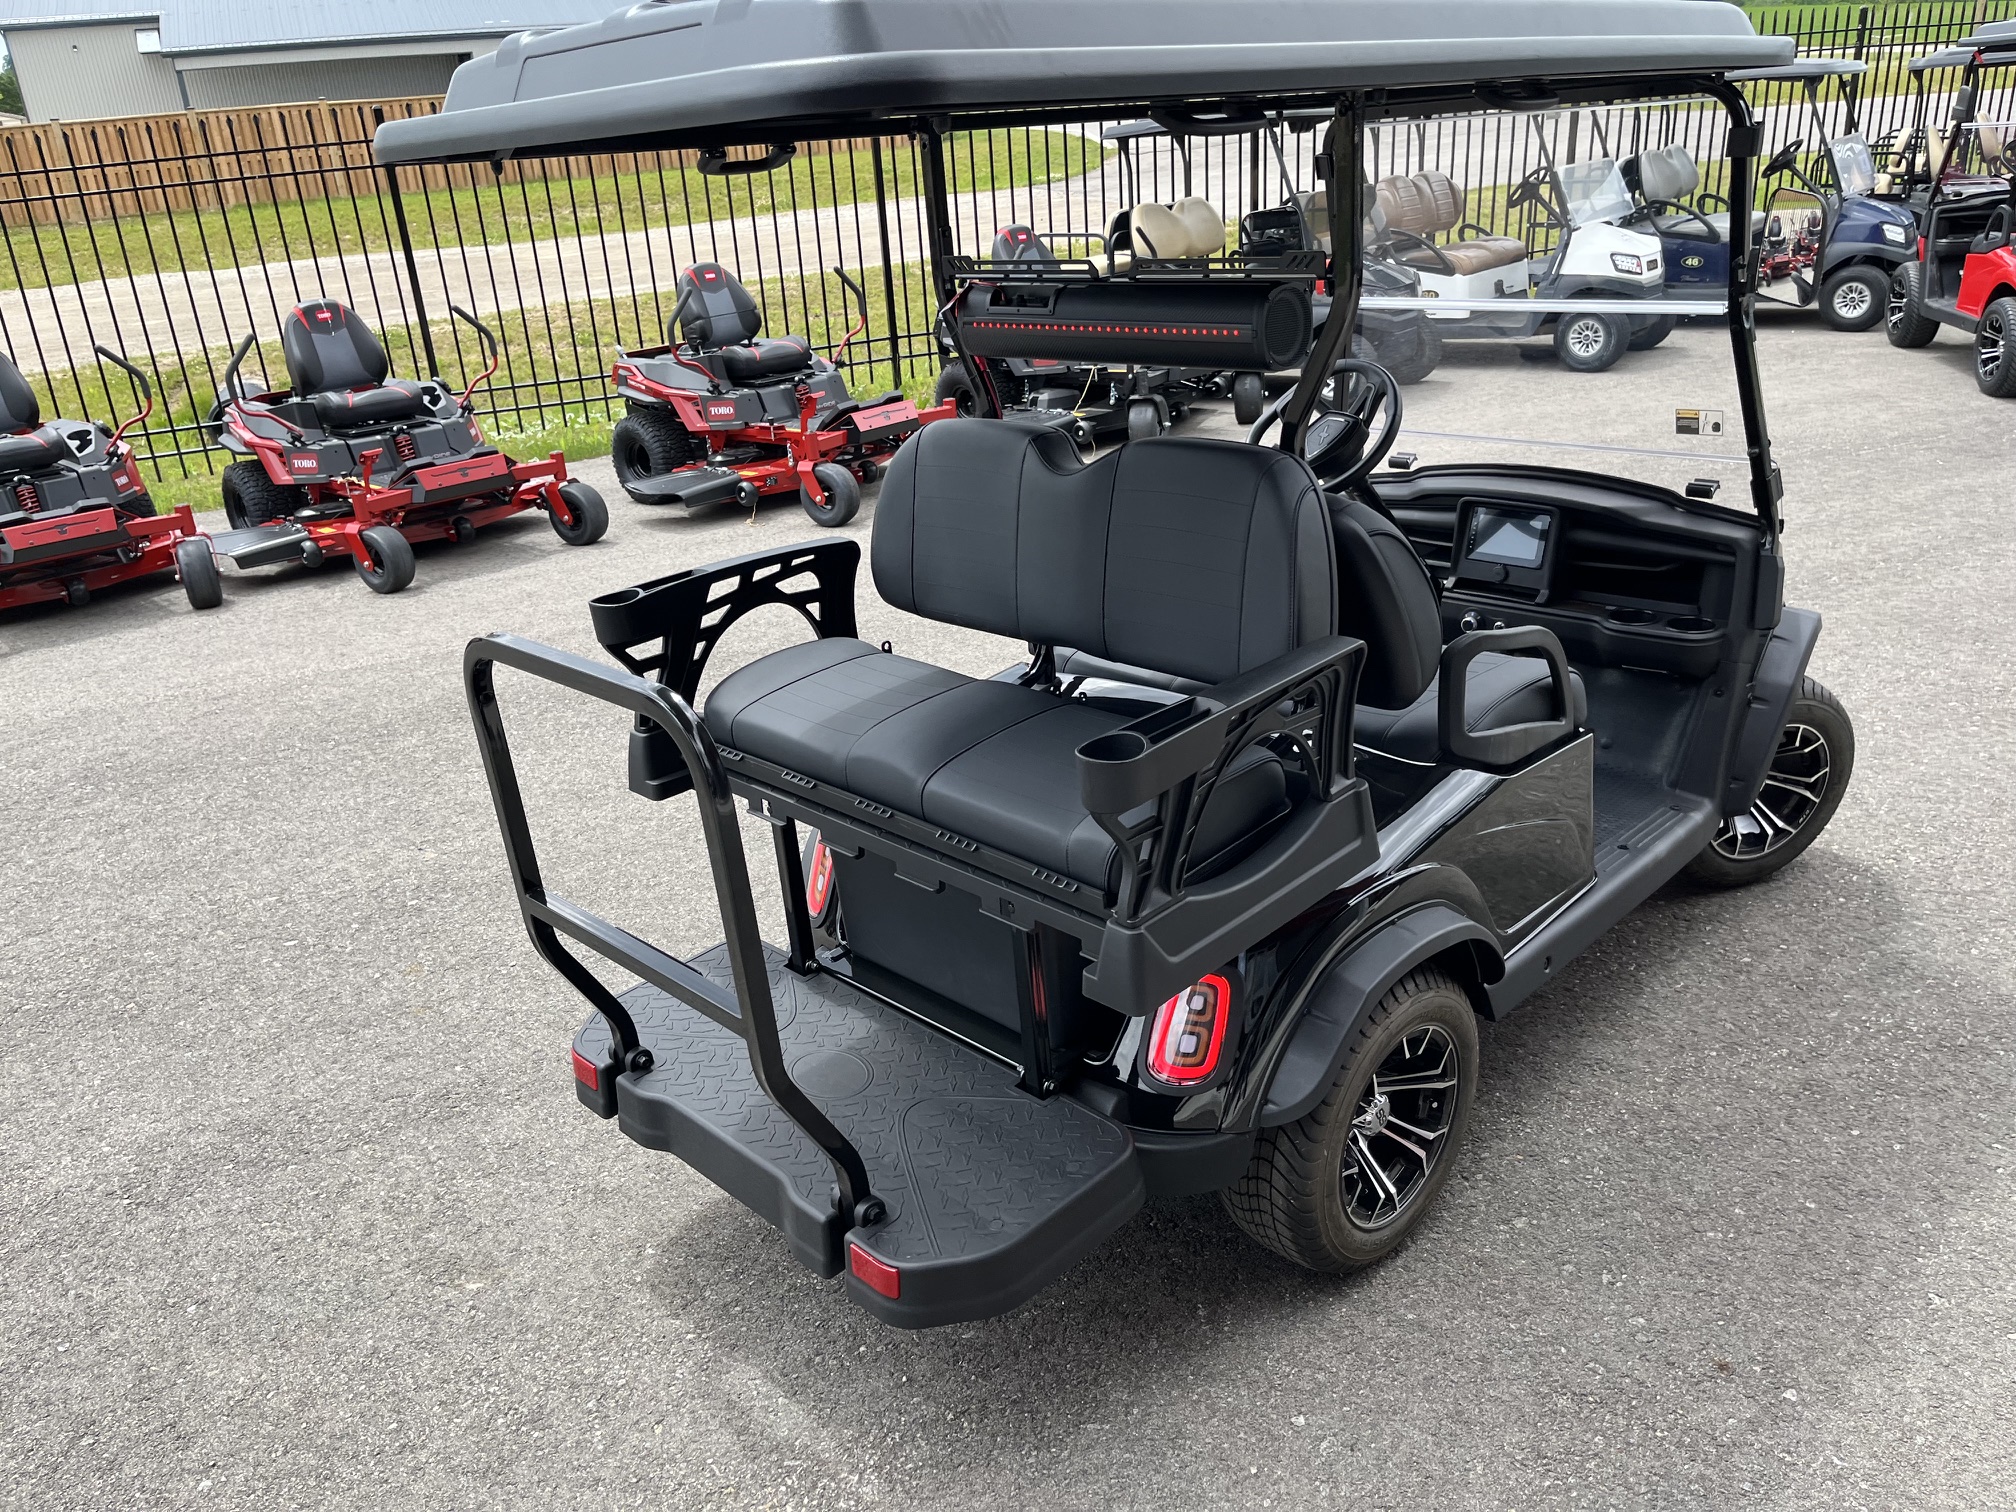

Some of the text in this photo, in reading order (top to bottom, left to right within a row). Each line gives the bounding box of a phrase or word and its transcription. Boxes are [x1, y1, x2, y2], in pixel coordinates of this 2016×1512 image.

[1685, 257, 1699, 266] 46
[709, 406, 734, 415] TORO
[292, 459, 317, 468] TORO
